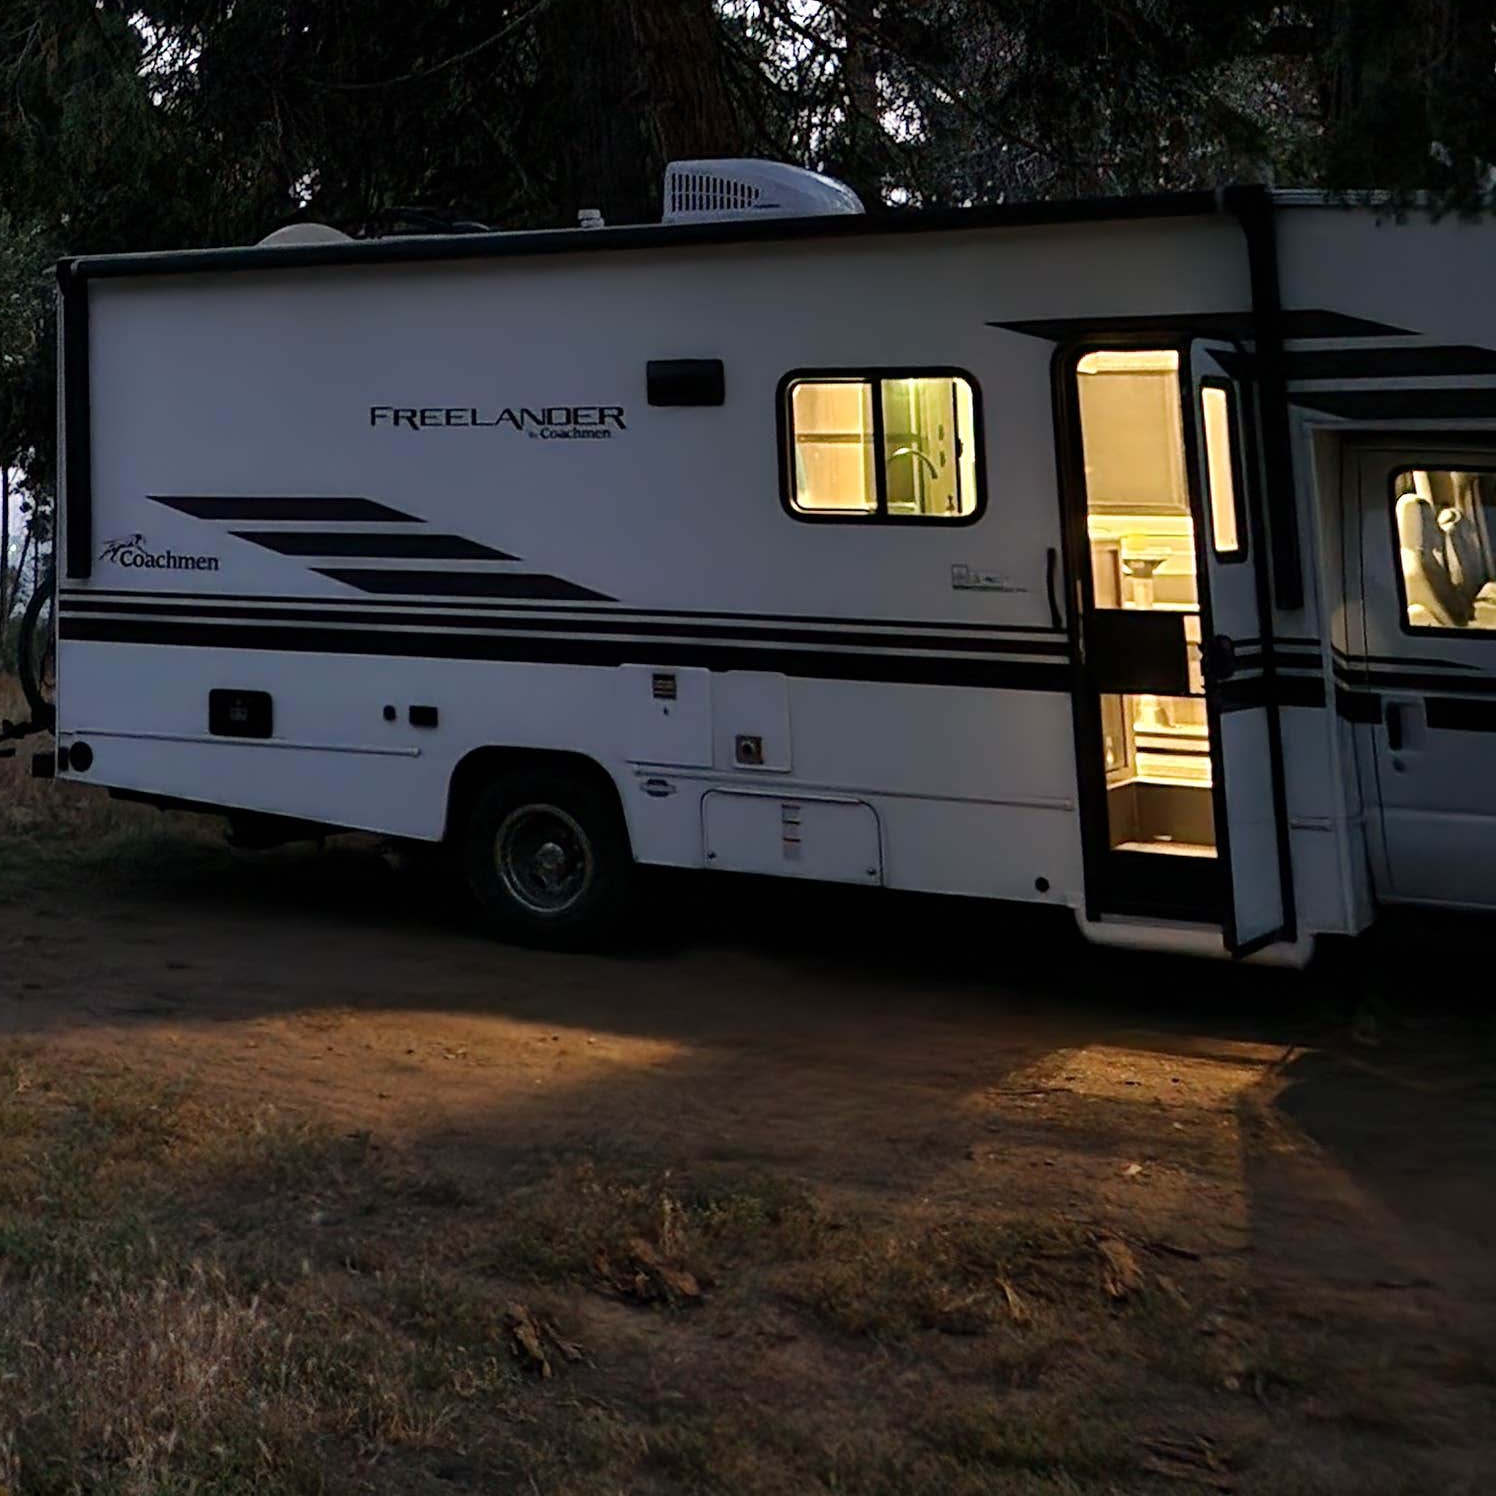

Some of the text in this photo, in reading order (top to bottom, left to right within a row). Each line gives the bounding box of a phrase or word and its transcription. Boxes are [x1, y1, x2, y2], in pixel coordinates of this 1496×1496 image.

[370, 406, 627, 430] FREELANDER
[540, 427, 612, 440] Coachmen
[119, 550, 220, 571] Coachmen
